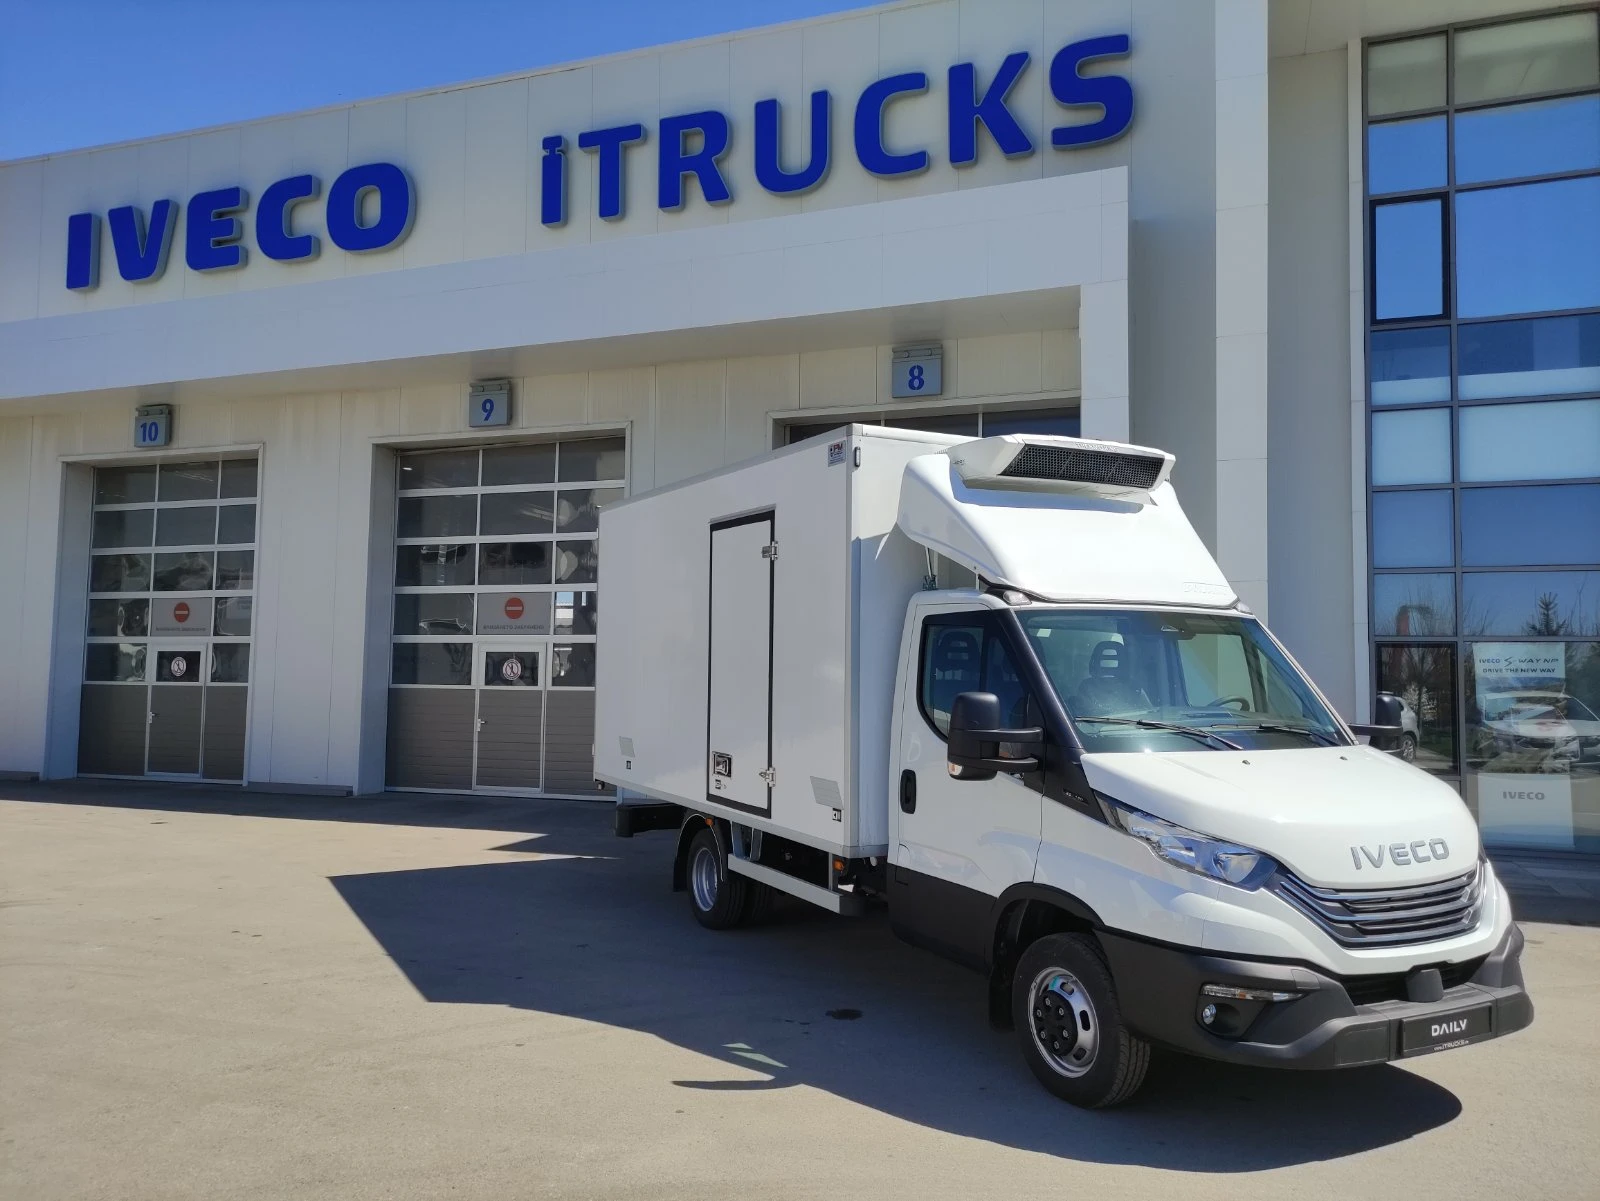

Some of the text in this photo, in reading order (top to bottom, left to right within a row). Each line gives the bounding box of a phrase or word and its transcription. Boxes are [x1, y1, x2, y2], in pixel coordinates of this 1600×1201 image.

[66, 162, 415, 290] IVECO
[908, 364, 925, 391] 8
[481, 398, 495, 422] 9
[140, 421, 159, 443] 10
[1502, 791, 1545, 801] IVECO
[1350, 838, 1450, 870] IVECO
[1431, 1018, 1468, 1037] DAILY
